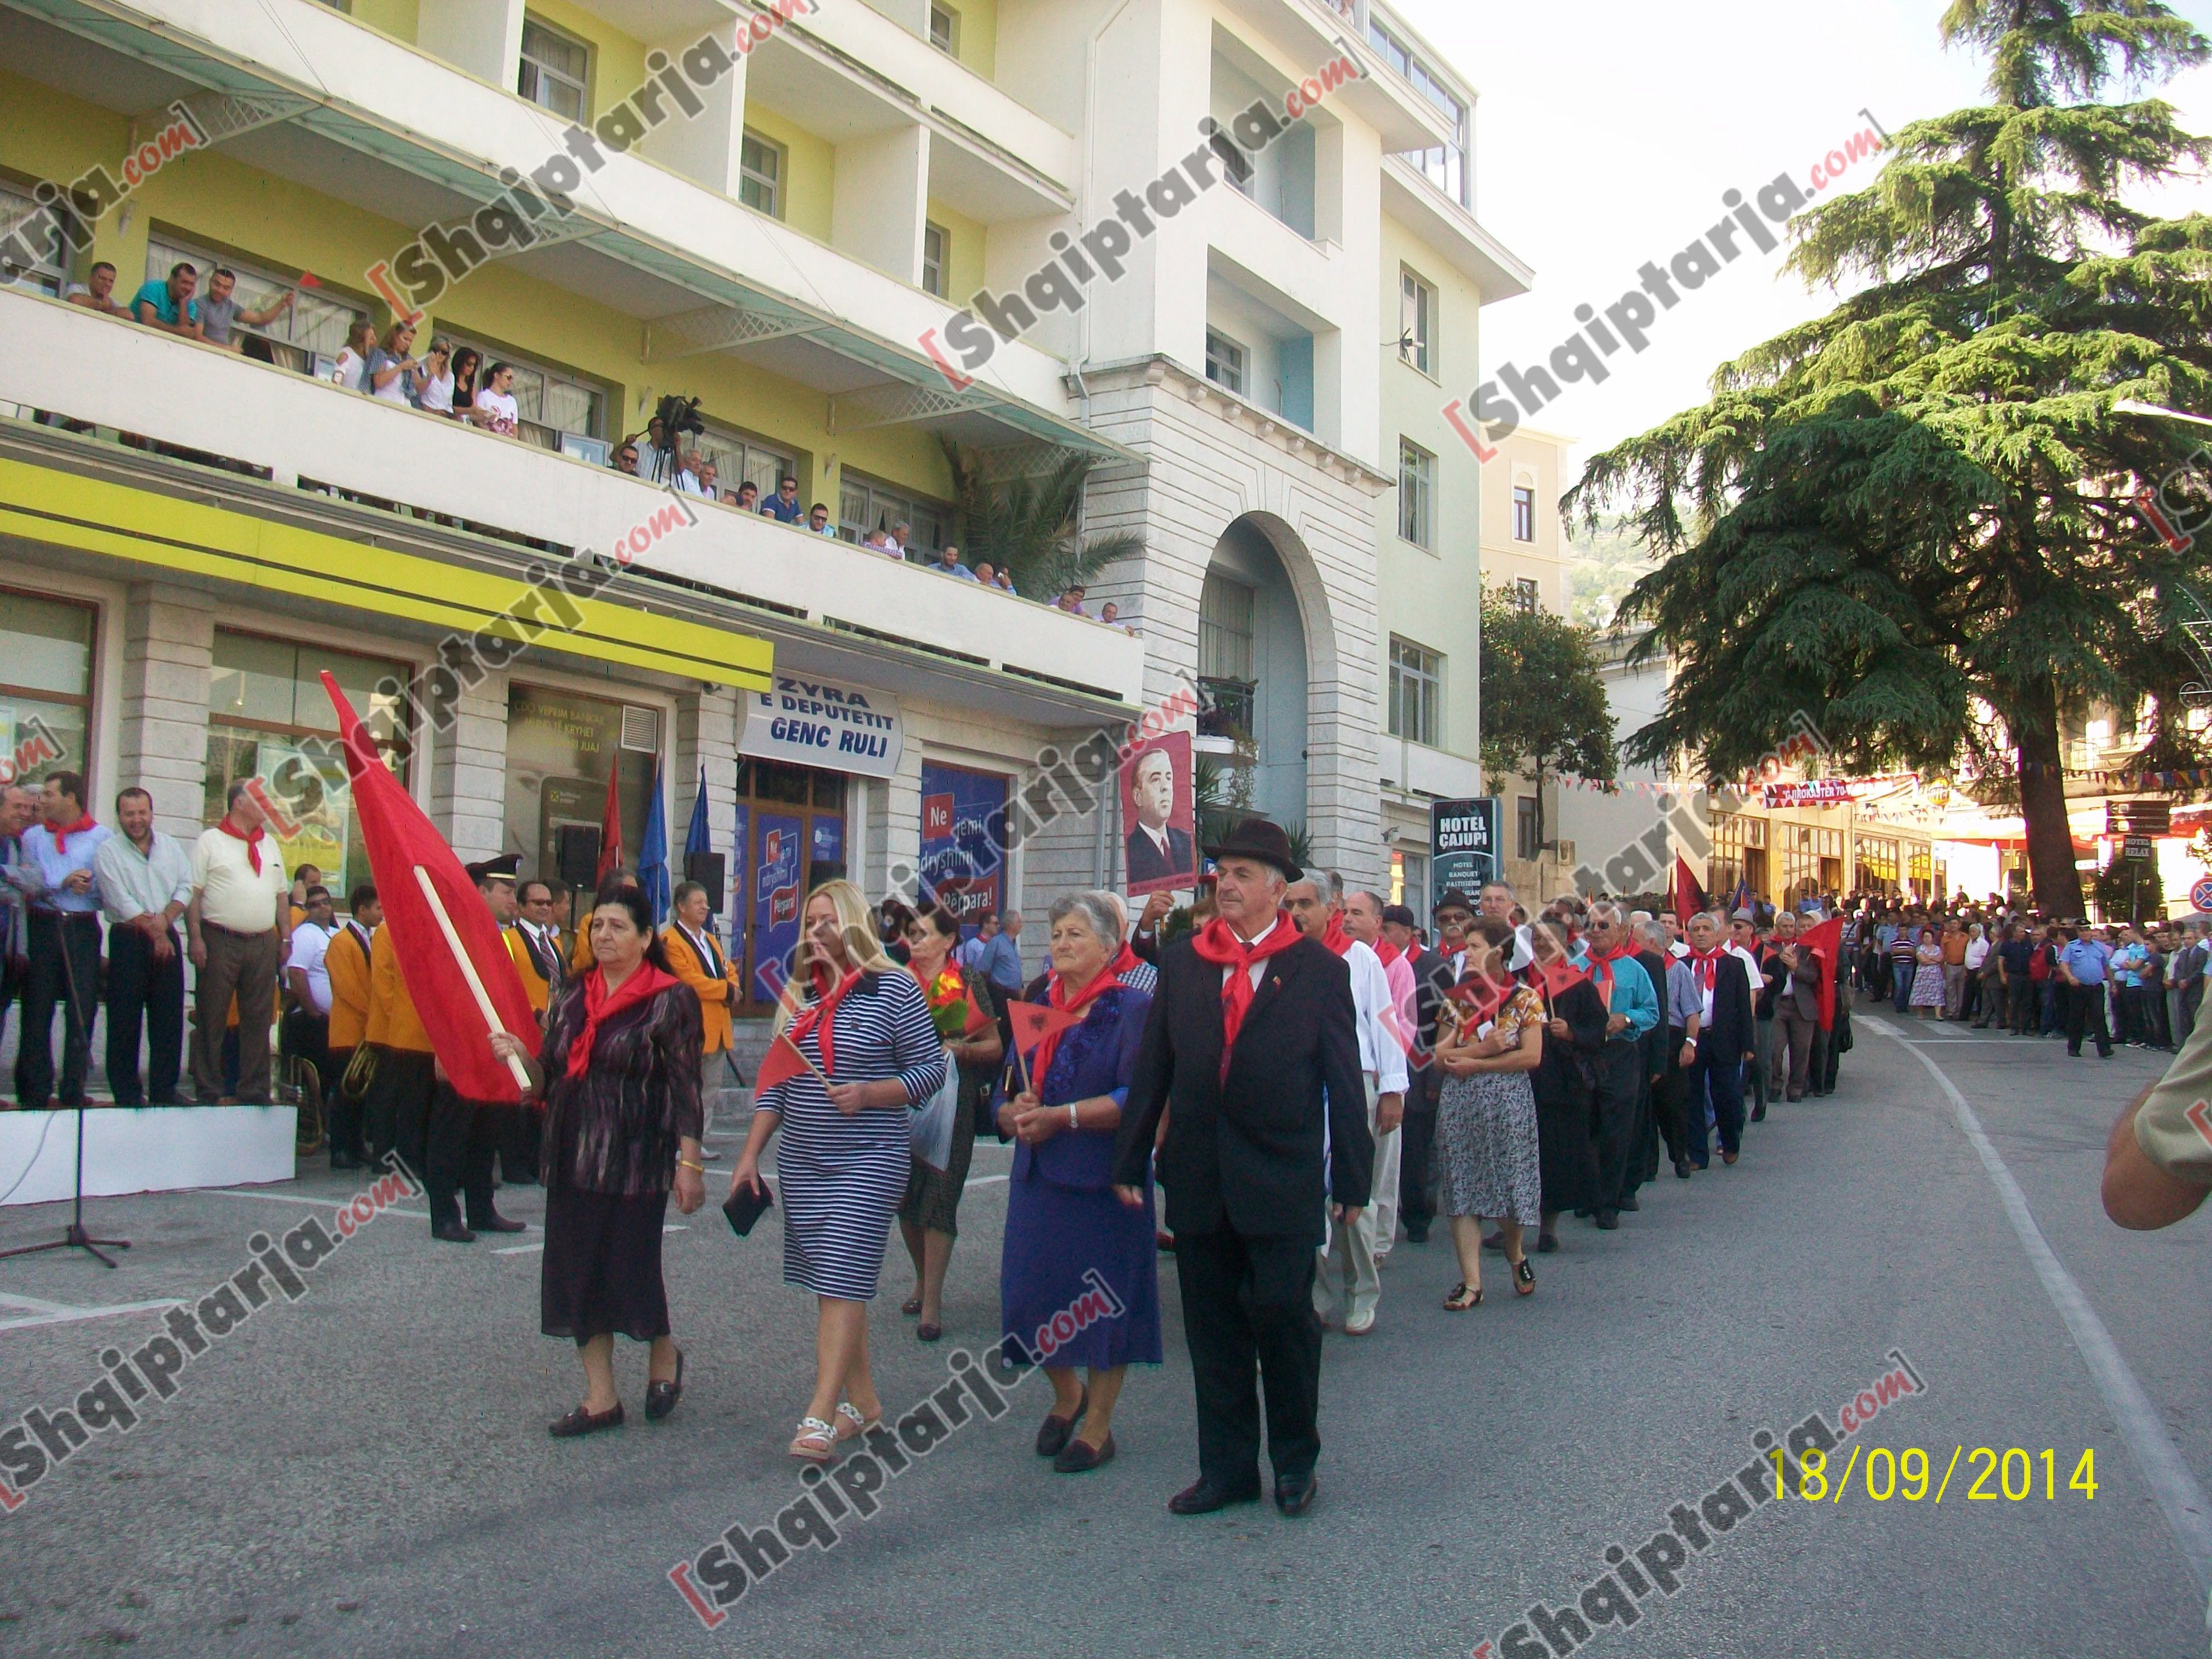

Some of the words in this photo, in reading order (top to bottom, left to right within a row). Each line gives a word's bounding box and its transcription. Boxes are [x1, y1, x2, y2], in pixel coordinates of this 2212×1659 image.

[776, 676, 871, 708] ZYRA
[759, 692, 773, 706] E
[781, 695, 893, 730] DEPUTETIT
[771, 717, 831, 747] GENC
[839, 730, 888, 758] RULI
[930, 807, 947, 827] Ne
[956, 814, 982, 839] jemi
[1440, 816, 1486, 833] HOTEL
[1439, 832, 1487, 849] ÇAJUPI
[943, 886, 992, 916] Përpara!
